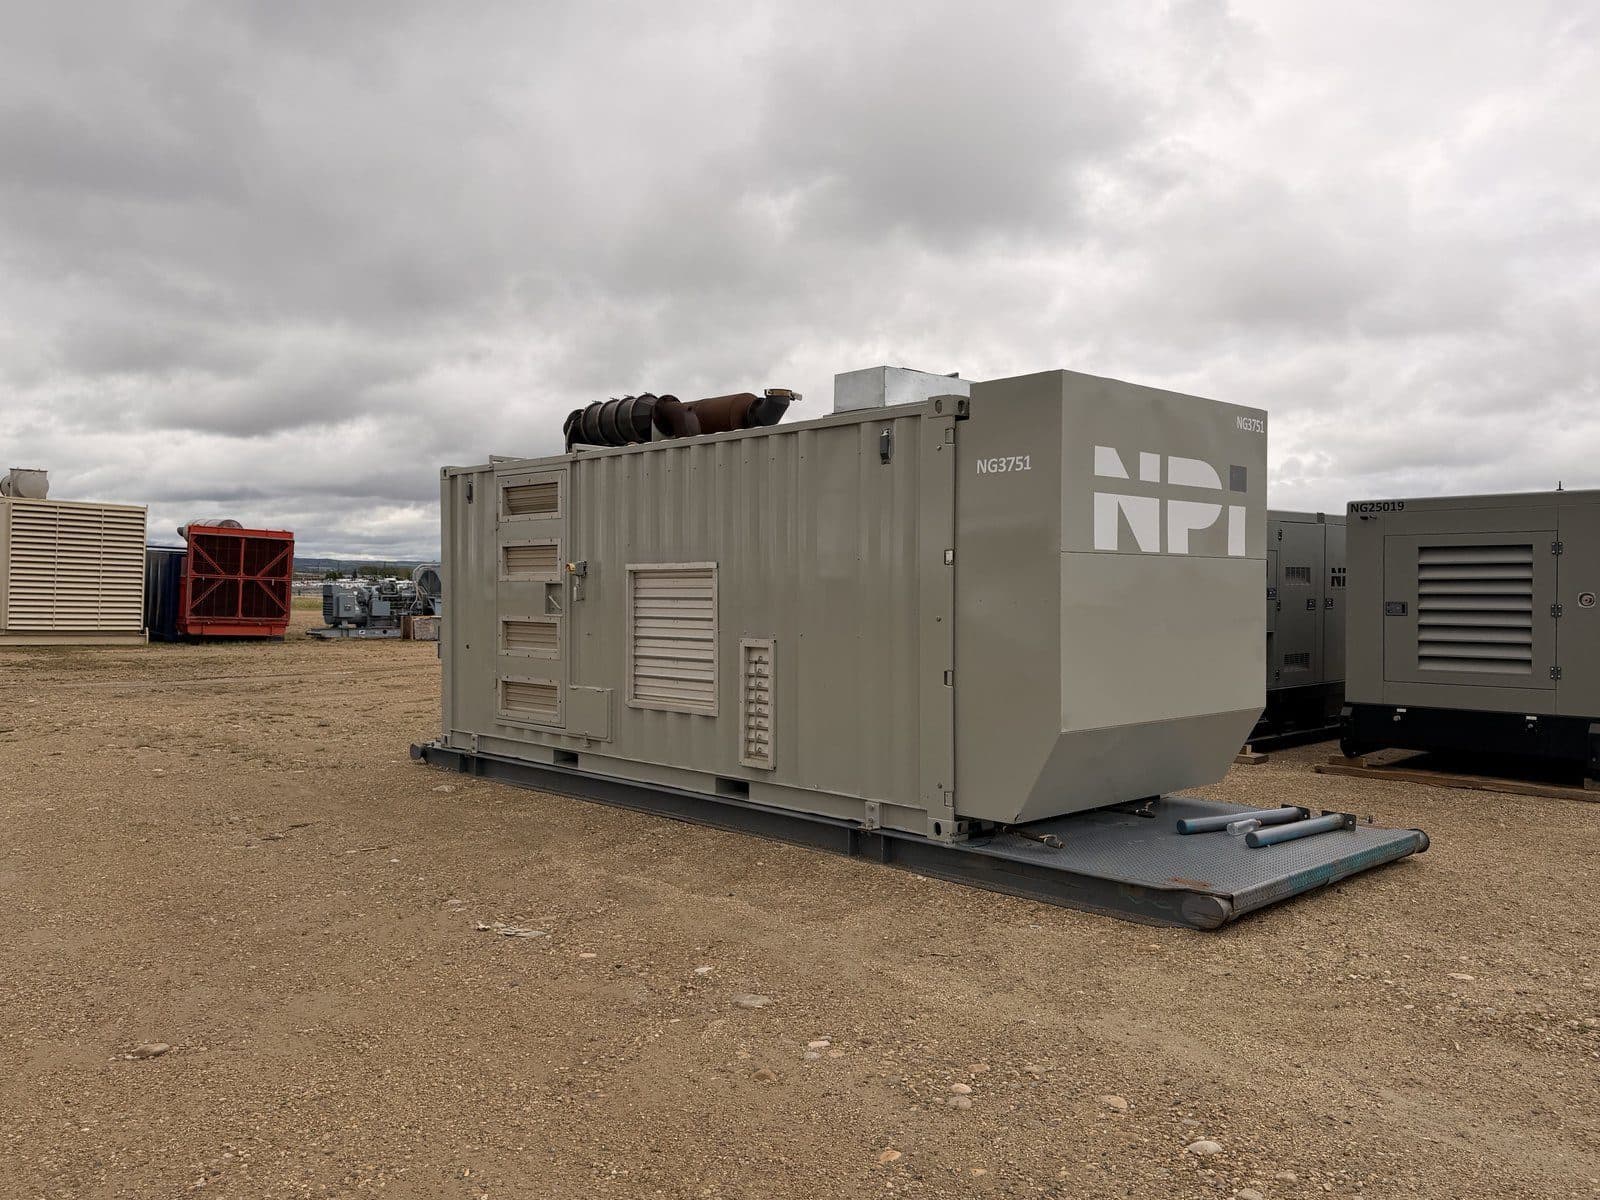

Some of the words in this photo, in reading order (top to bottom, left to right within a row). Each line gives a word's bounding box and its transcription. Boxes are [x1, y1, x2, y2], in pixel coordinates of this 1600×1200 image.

[1236, 415, 1264, 433] NG3751
[976, 455, 1031, 474] NG3751
[1350, 501, 1405, 513] NG25019
